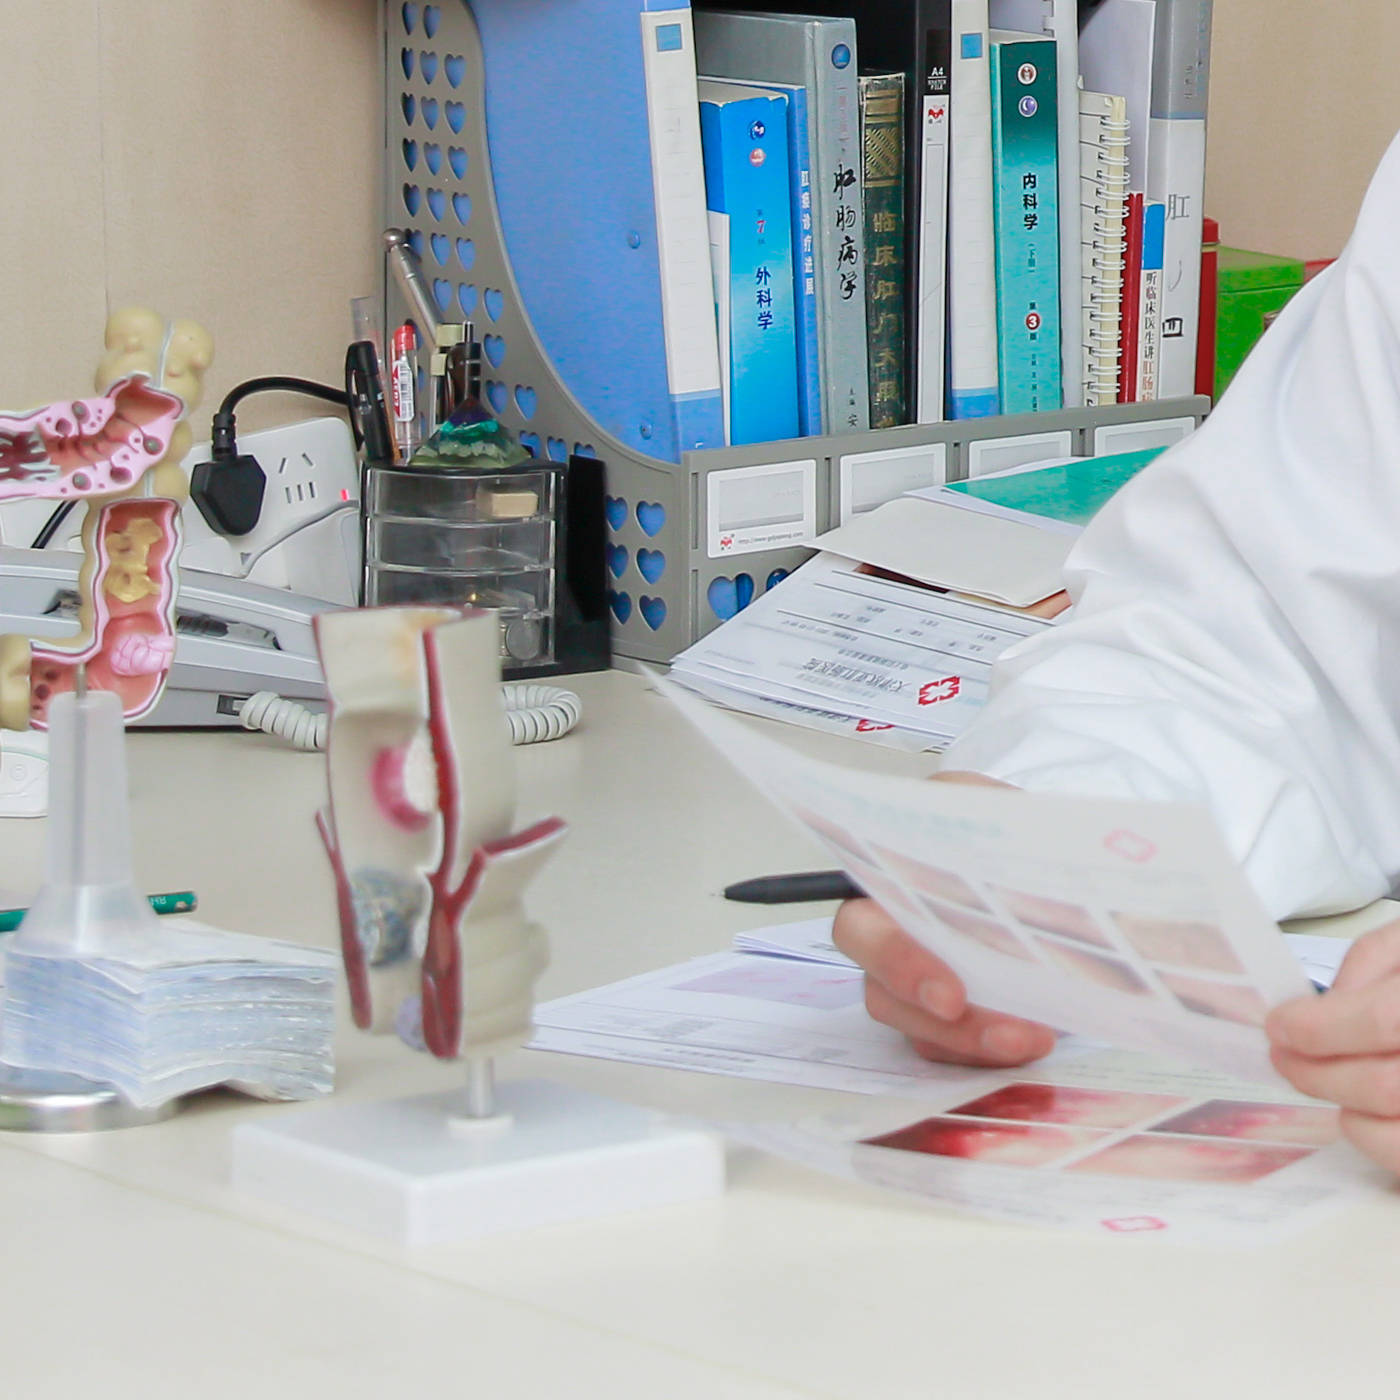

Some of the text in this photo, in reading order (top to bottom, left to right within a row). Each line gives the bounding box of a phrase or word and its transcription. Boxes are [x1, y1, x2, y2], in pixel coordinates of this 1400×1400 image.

[931, 66, 944, 76] A4
[1022, 173, 1039, 231] 内科学
[1165, 193, 1191, 221] 肛
[755, 265, 773, 330] 外科学
